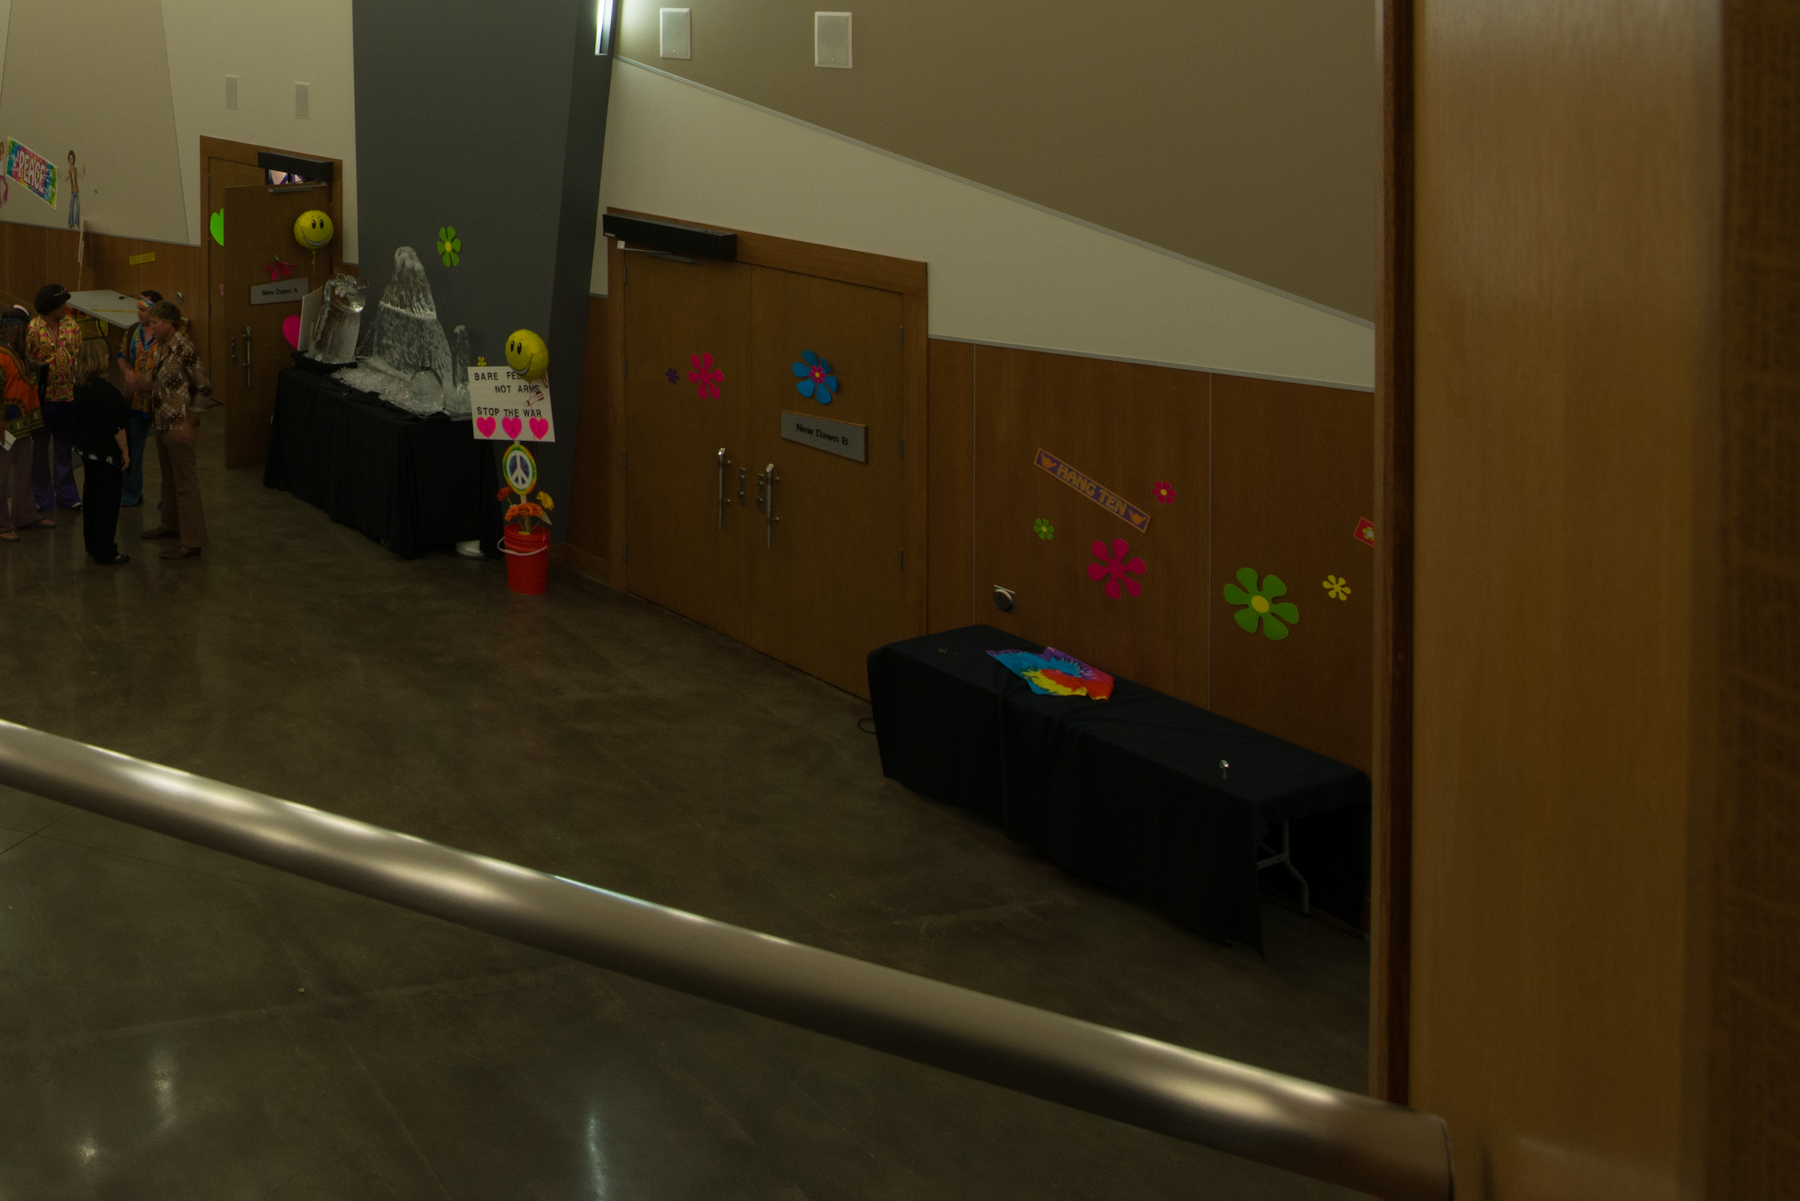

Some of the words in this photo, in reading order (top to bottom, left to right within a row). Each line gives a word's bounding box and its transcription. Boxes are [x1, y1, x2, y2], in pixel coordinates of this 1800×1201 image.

[18, 149, 45, 195] PEACE
[474, 372, 499, 381] BARE
[506, 371, 522, 380] FE
[494, 384, 512, 393] NOT
[517, 384, 540, 393] ARMS
[476, 406, 500, 416] STOP
[503, 408, 519, 418] THE
[522, 409, 542, 418] WAR
[796, 423, 814, 435] New
[815, 428, 839, 443] Dawn
[841, 436, 849, 446] B
[1056, 463, 1097, 497] HANG
[1098, 489, 1127, 516] TEN
